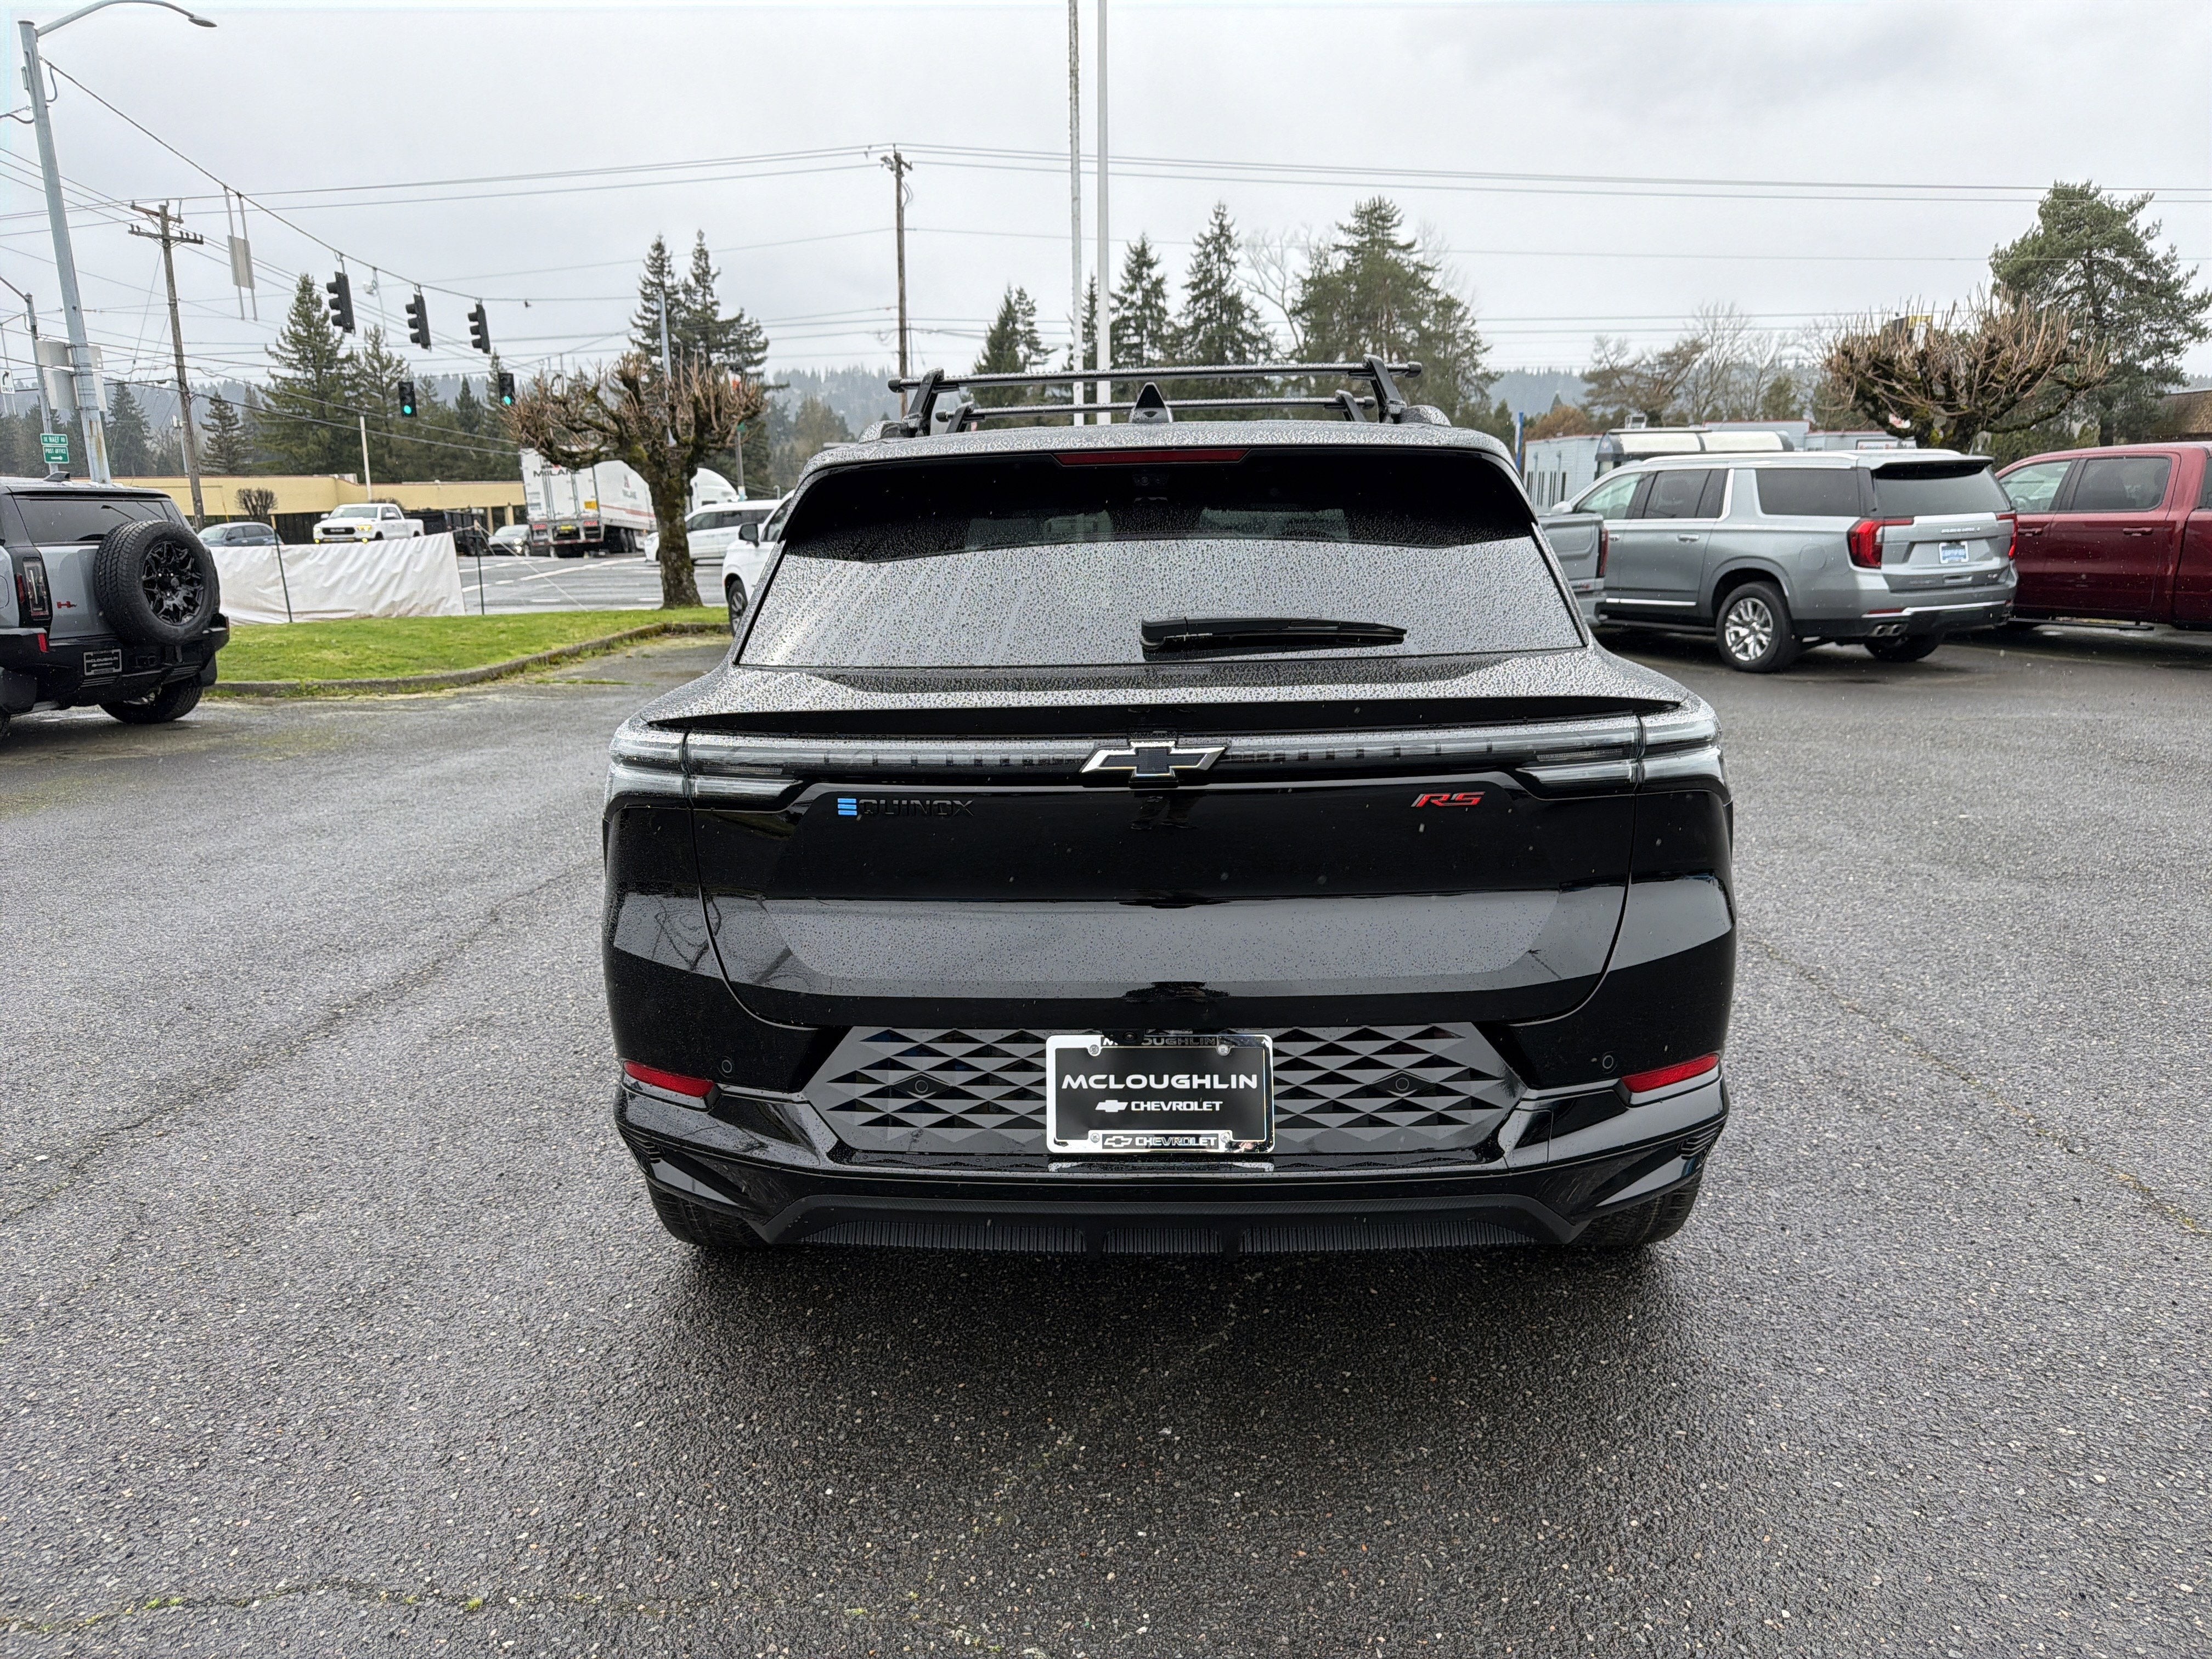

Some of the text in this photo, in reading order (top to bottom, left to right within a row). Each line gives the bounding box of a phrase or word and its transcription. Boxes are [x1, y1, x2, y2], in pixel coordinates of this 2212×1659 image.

[1410, 791, 1486, 808] RS
[837, 798, 974, 817] EQUINOX
[1103, 1037, 1216, 1046] MOUGHLIN
[1062, 1074, 1257, 1089] MCLOUGHLIN
[1131, 1101, 1223, 1111] CHEVROLET
[1135, 1137, 1217, 1146] CHEVROLET
